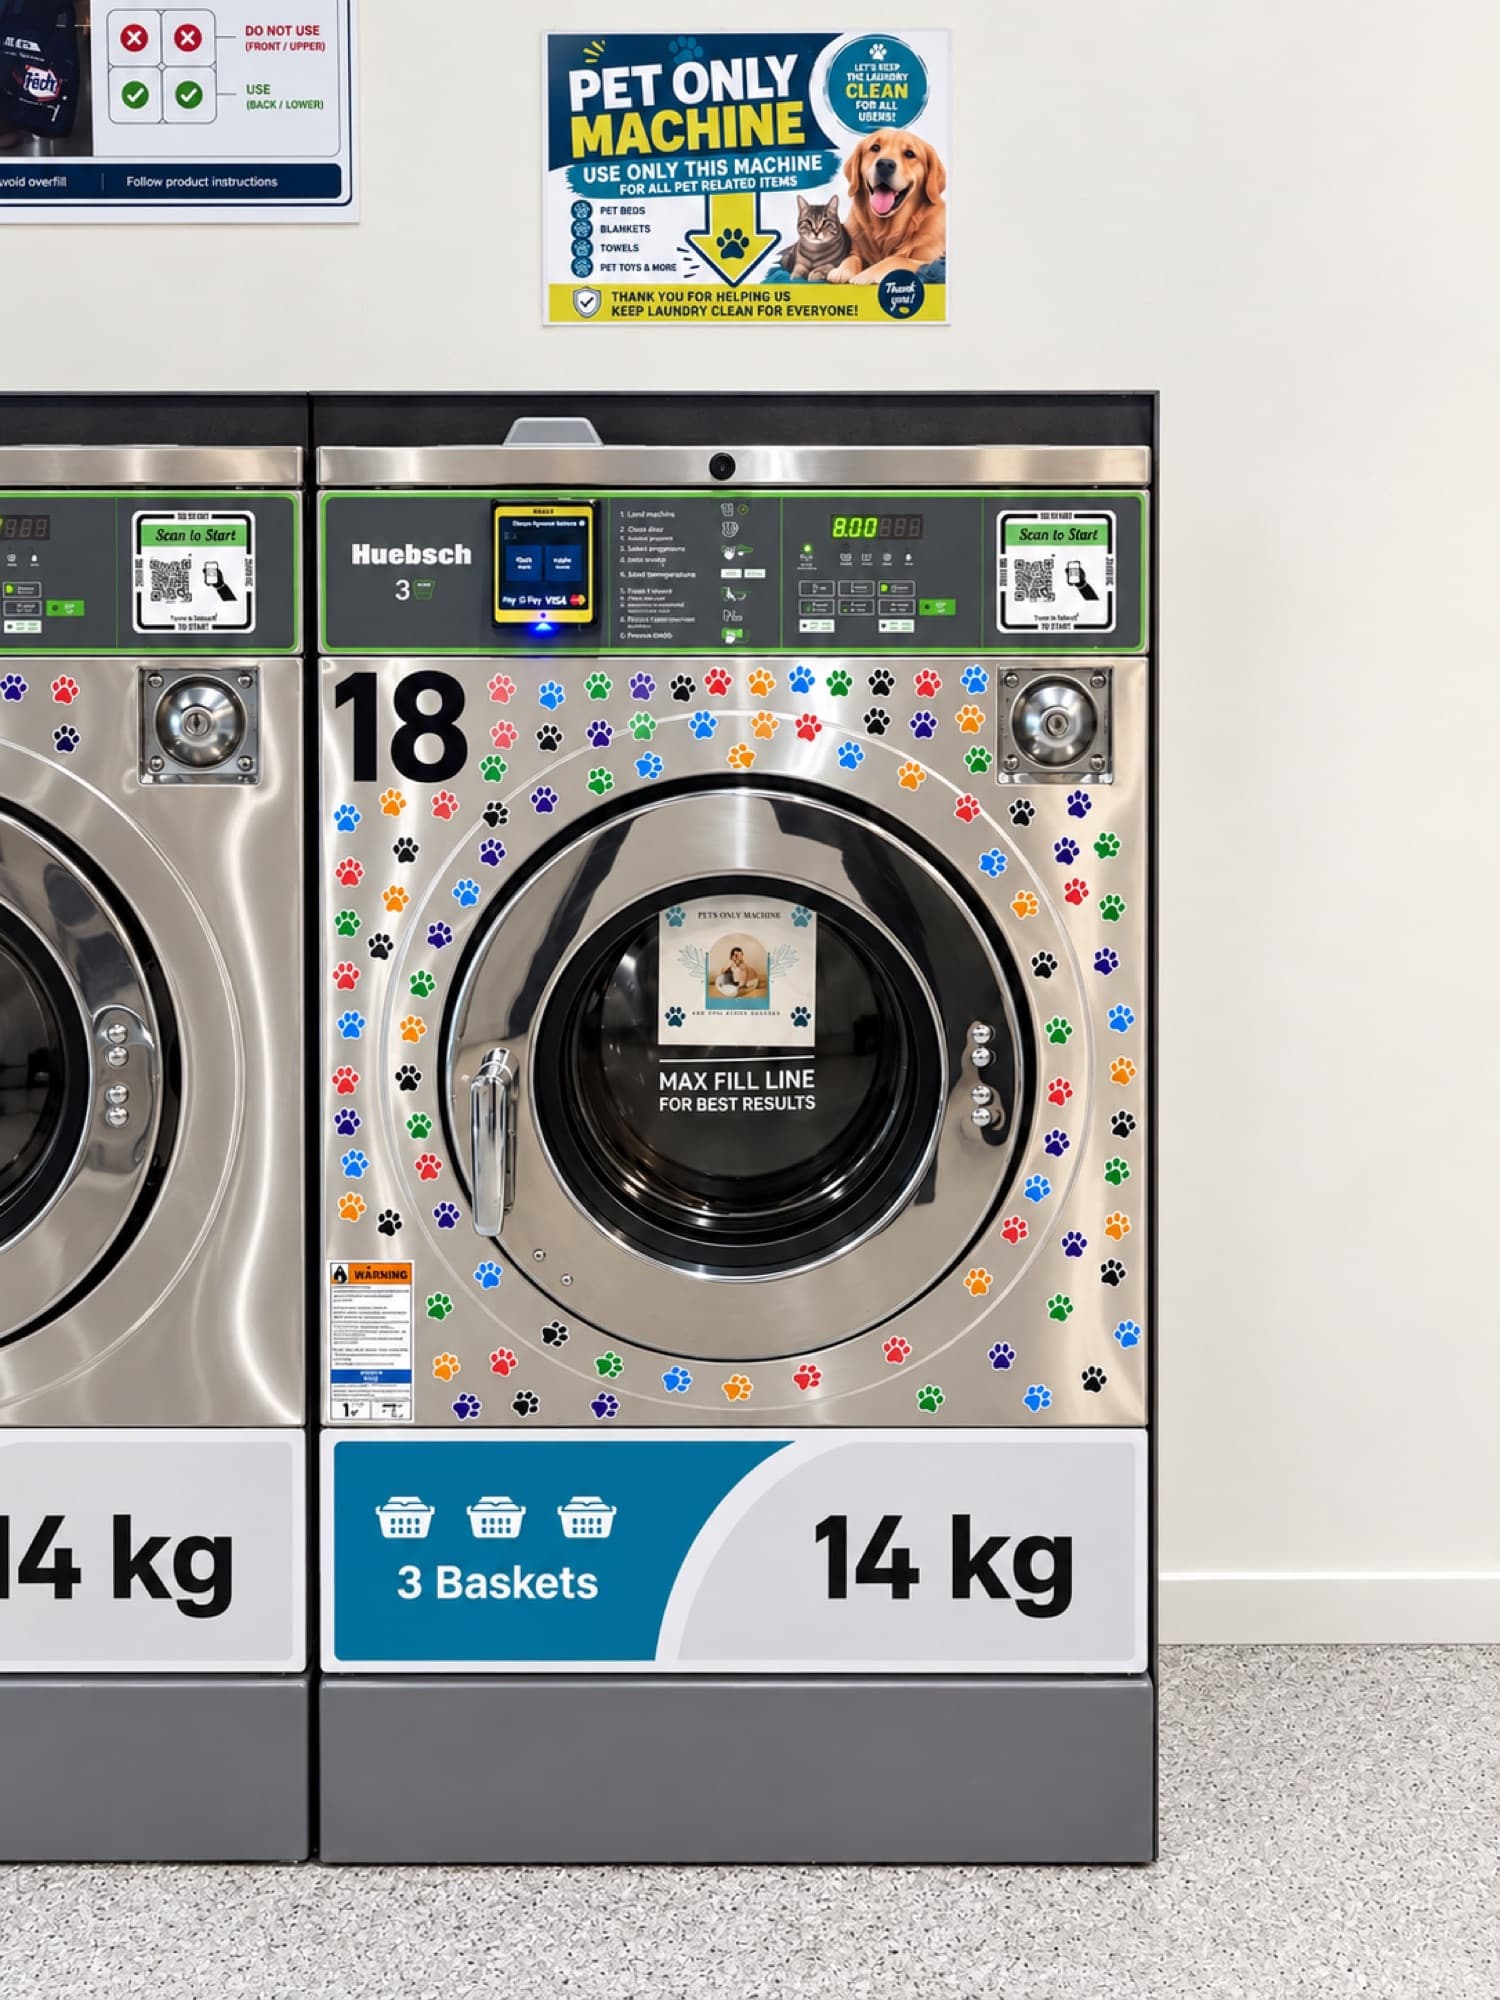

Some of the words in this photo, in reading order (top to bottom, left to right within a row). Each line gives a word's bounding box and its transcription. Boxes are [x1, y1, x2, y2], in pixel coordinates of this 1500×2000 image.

[245, 25, 263, 36] DO
[266, 25, 292, 36] NOT
[297, 25, 320, 36] USE
[245, 41, 282, 52] (FRONT
[291, 41, 326, 52] UPPER)
[246, 84, 271, 95] USE
[569, 65, 663, 112] PET
[671, 54, 798, 105] ONLY
[846, 83, 908, 98] CLEAN
[246, 100, 276, 110] (BACK
[286, 100, 324, 110] LOWER)
[879, 101, 898, 110] ALL
[570, 101, 805, 159] MACHINE
[583, 164, 621, 184] USE
[627, 161, 682, 181] ONLY
[684, 158, 730, 178] THIS
[734, 155, 822, 176] MACHINE
[28, 176, 67, 187] overfill
[127, 176, 162, 187] Follow
[166, 176, 209, 191] product
[212, 176, 278, 187] instructions
[620, 184, 645, 196] FOR
[648, 182, 672, 194] ALL
[674, 181, 698, 193] PET
[702, 178, 756, 192] RELATED
[760, 176, 798, 189] ITEMS
[600, 206, 617, 215] PET
[600, 243, 640, 253] TOWELS
[600, 263, 617, 272] PET
[619, 263, 642, 272] TOYS
[652, 263, 677, 272] MORE
[612, 291, 654, 302] THANK
[658, 291, 683, 302] YOU
[687, 291, 712, 302] FOR
[716, 291, 770, 302] HELPING
[774, 291, 791, 302] US
[612, 305, 643, 317] KEEP
[647, 305, 707, 317] LAUNDRY
[711, 305, 753, 317] CLEAN
[757, 305, 783, 317] FOR
[787, 305, 858, 317] EVERYONE!
[156, 528, 186, 542] Scan
[190, 529, 201, 541] to
[206, 528, 237, 542] Start
[1020, 528, 1049, 541] Scan
[1053, 529, 1064, 541] to
[1068, 528, 1098, 541] Start
[351, 543, 472, 565] Huebsch
[395, 579, 410, 600] 3
[335, 670, 468, 783] 18
[659, 1071, 708, 1091] MAX
[714, 1071, 759, 1090] FILL
[766, 1069, 815, 1089] LINE
[659, 1097, 692, 1112] FOR
[697, 1097, 738, 1111] BEST
[743, 1095, 815, 1110] RESULTS
[354, 1270, 408, 1280] WARNING
[112, 1514, 232, 1618] kg
[815, 1514, 920, 1601] 14
[951, 1513, 1072, 1619] kg
[397, 1566, 422, 1600] 3
[435, 1565, 598, 1601] Baskets
